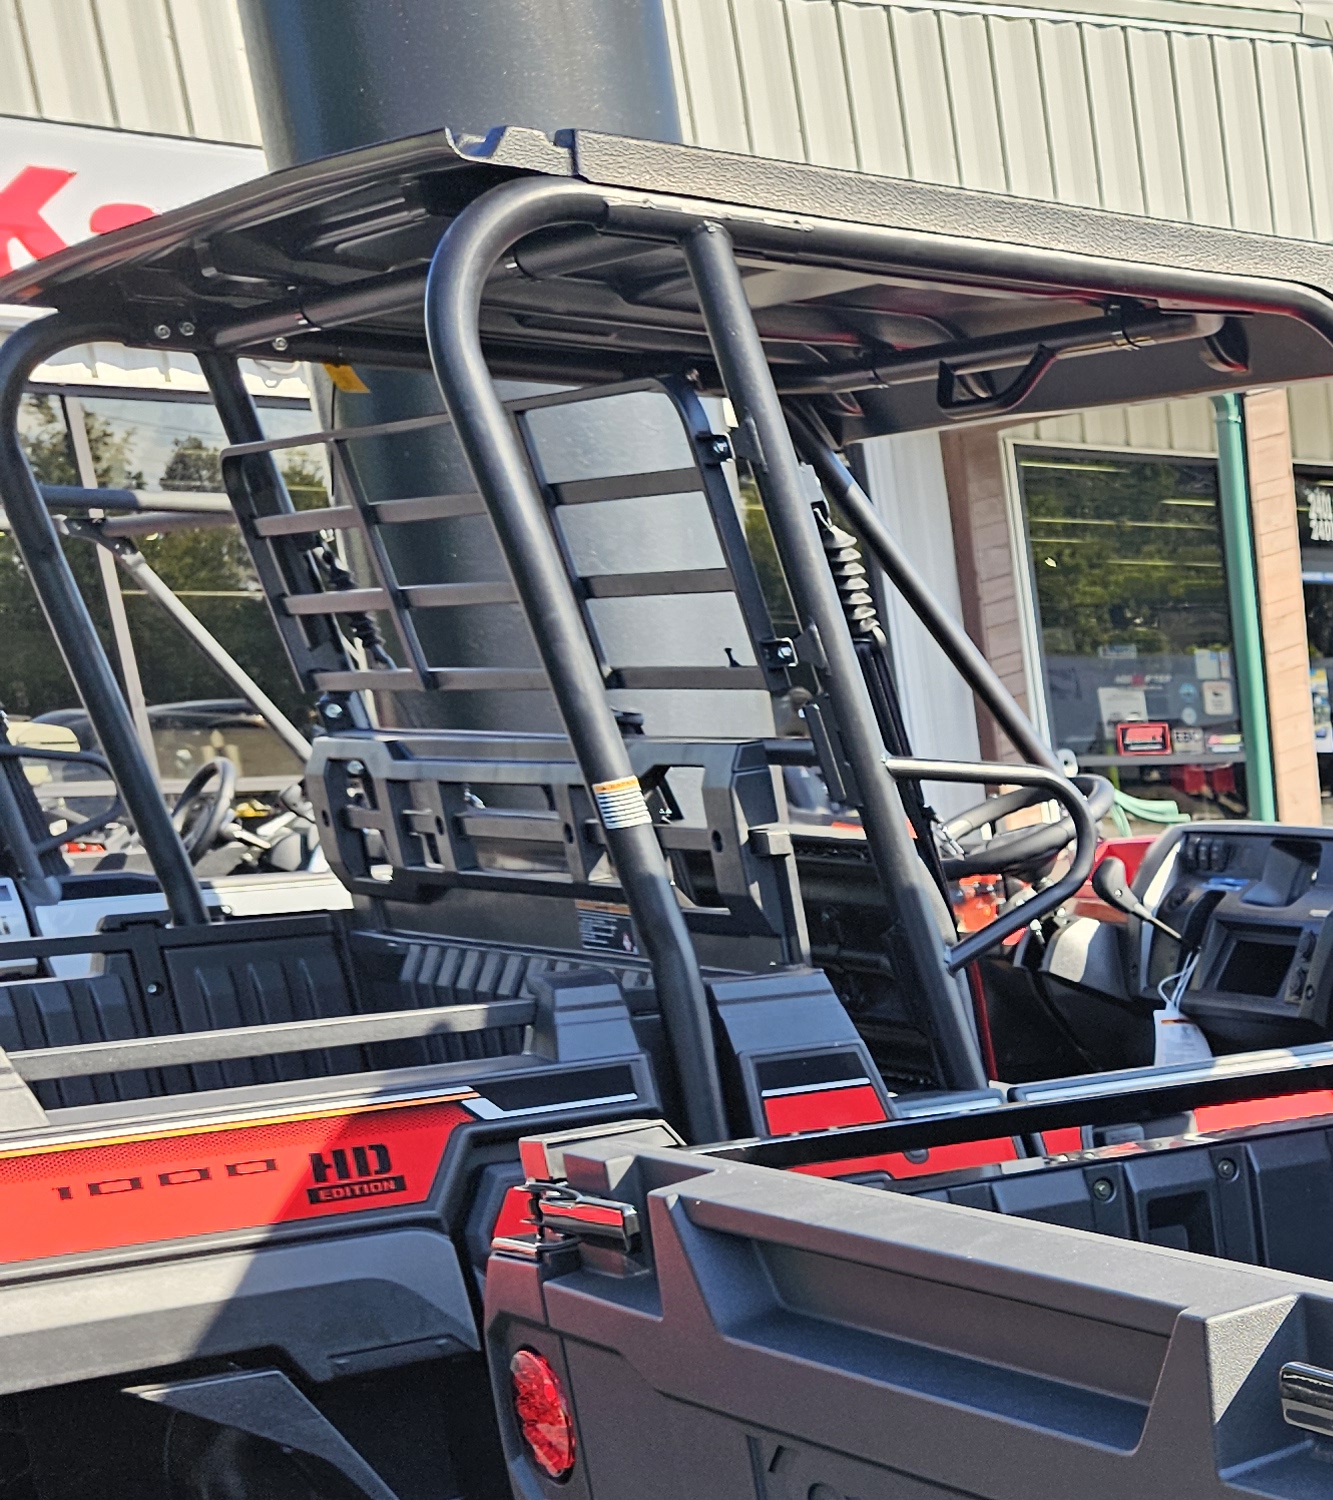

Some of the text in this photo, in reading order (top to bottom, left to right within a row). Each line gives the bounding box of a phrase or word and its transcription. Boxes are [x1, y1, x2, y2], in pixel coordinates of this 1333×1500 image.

[51, 1157, 279, 1201] 1000
[310, 1143, 393, 1183] HD
[317, 1178, 397, 1202] EDITION
